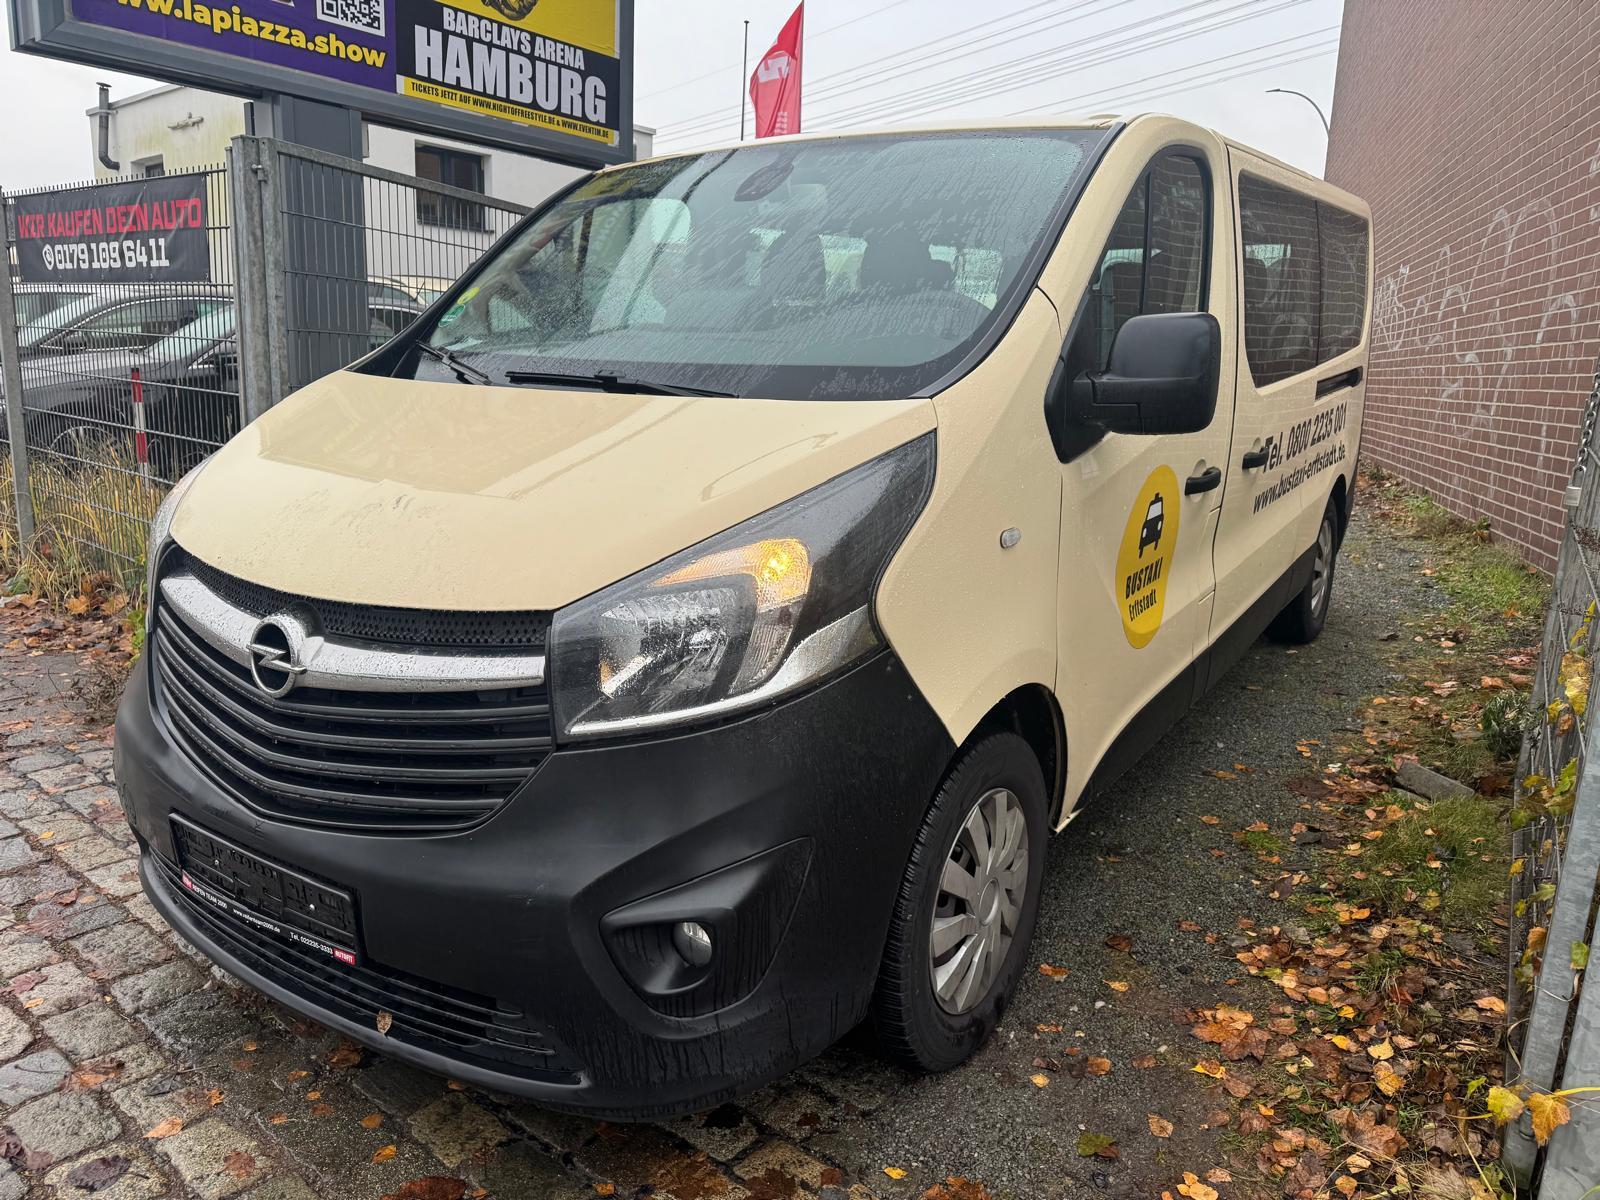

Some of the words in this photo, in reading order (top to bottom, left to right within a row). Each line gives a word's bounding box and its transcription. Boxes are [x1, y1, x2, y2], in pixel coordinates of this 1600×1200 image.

[442, 7, 531, 54] BARCLAYS
[534, 36, 585, 70] ARENA
[414, 24, 607, 124] HAMBURG
[411, 82, 439, 97] TICKETS
[440, 90, 458, 102] JETZT
[459, 93, 471, 105] AUF
[472, 97, 555, 126] WWW.NIGHTOFFREESTYLE.DE
[561, 119, 609, 139] WWW.EVENTIM.DE
[18, 213, 45, 239] WIR
[48, 208, 103, 238] KAUFEN
[106, 202, 149, 234] DEIN
[151, 198, 201, 230] AUTO
[55, 243, 89, 270] 0179
[91, 241, 121, 269] 109
[122, 239, 147, 268] 64
[149, 237, 170, 267] 11
[1286, 418, 1312, 461] 0800
[1310, 408, 1335, 447] 2235
[1333, 401, 1348, 434] 001
[1253, 440, 1346, 515] www.bustaxi-erftstadt.de
[1125, 556, 1163, 600] BUSTAXI
[1128, 588, 1157, 622] Erftstadt
